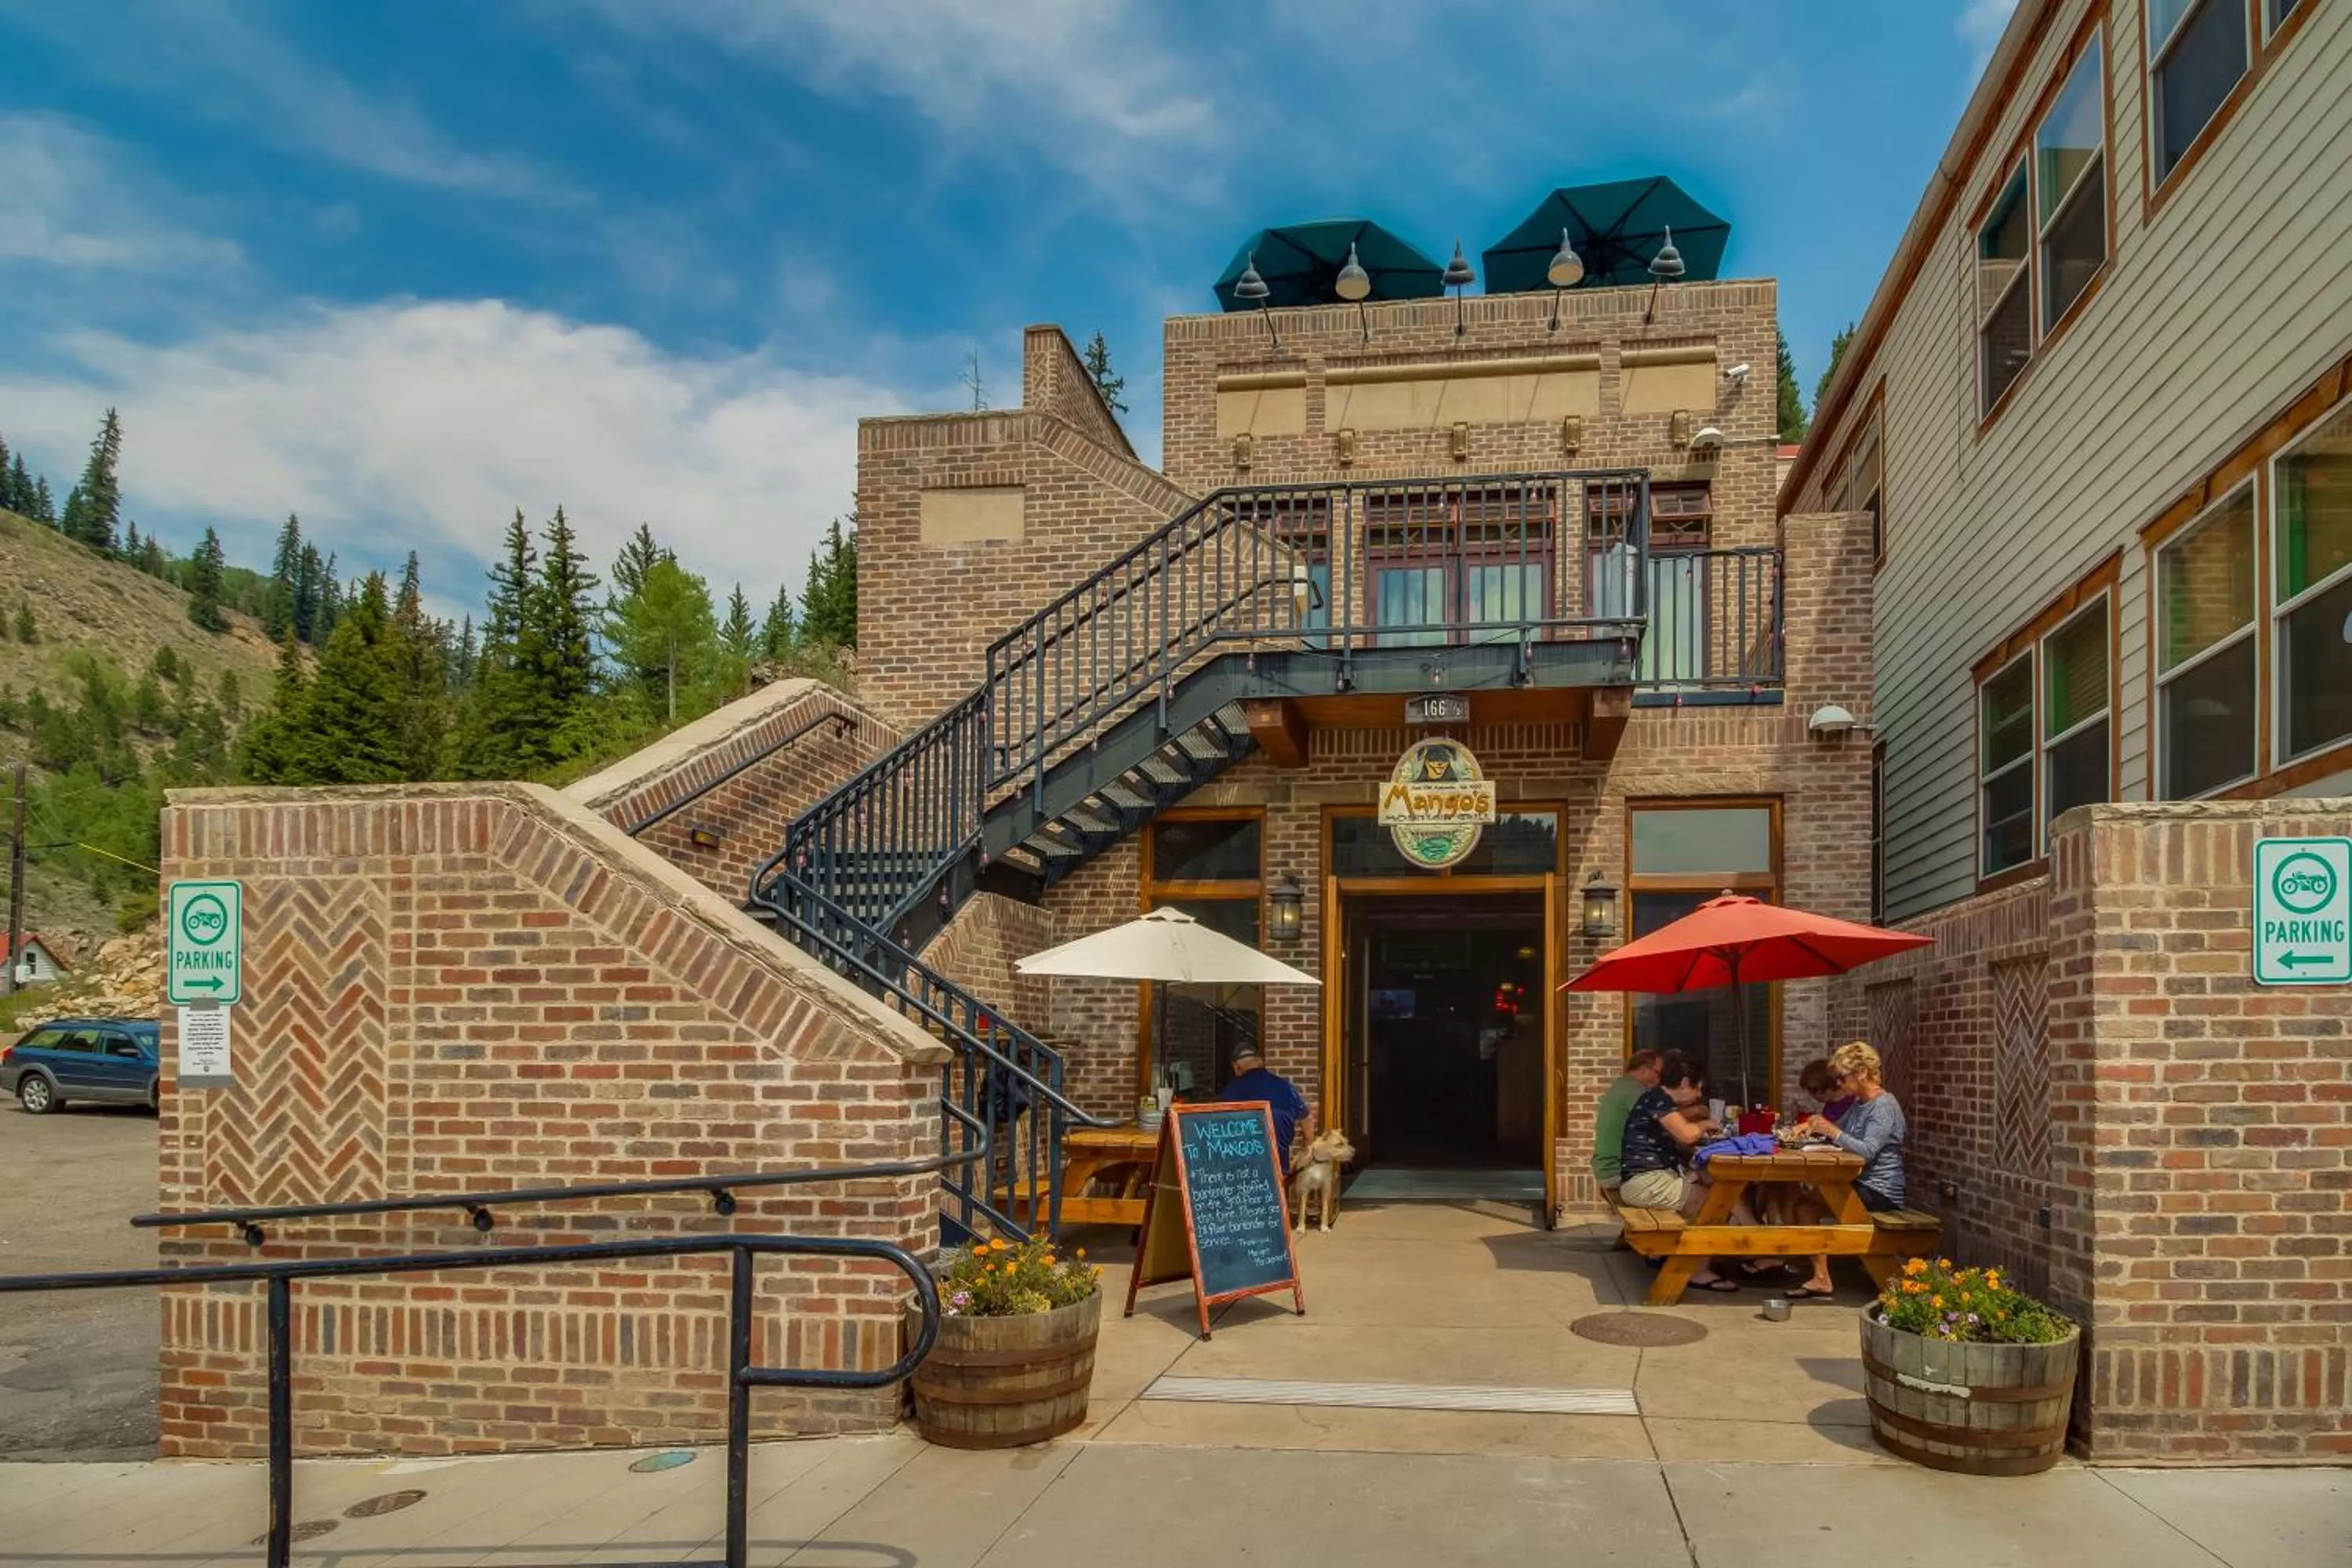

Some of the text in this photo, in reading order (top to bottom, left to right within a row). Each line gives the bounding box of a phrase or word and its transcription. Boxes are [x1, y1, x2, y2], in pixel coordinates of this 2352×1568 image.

[1425, 699, 1446, 716] 166
[1383, 784, 1490, 820] Mango's
[2265, 920, 2345, 944] PARKING
[176, 951, 233, 970] PARKING
[1193, 1119, 1264, 1141] WELCOME
